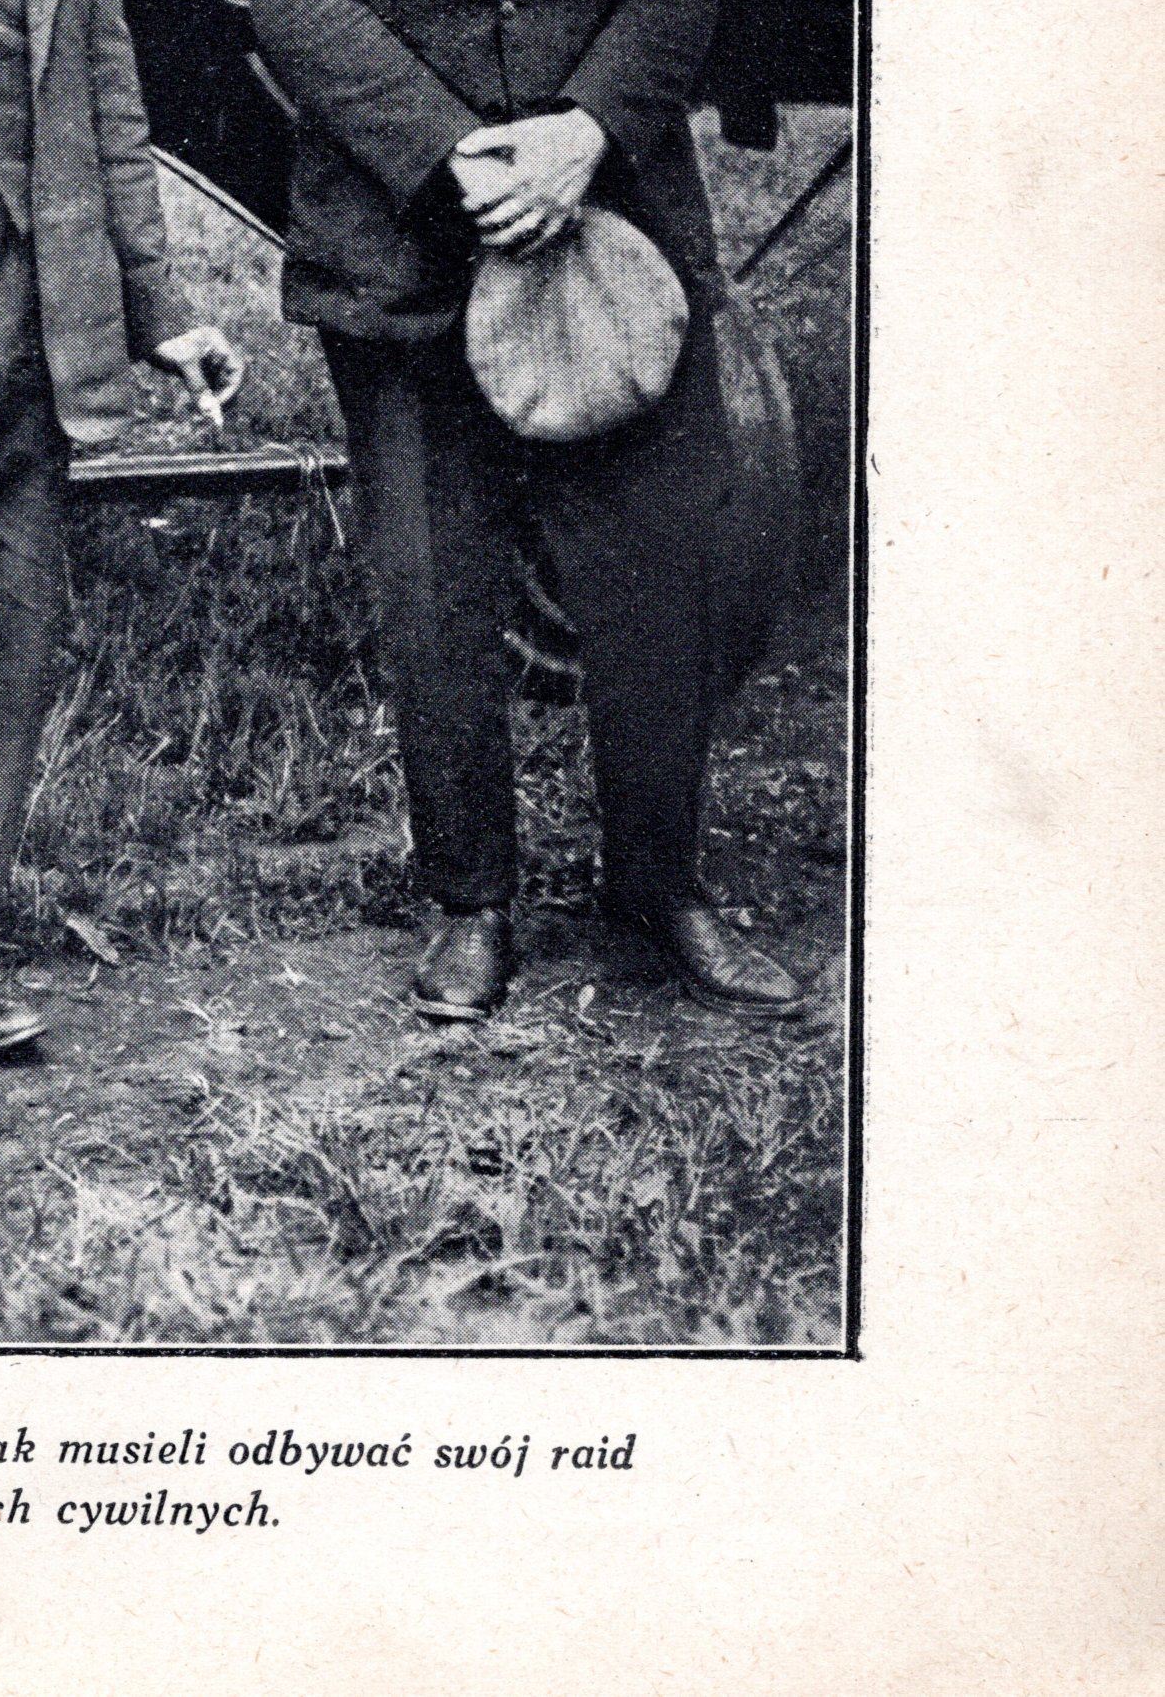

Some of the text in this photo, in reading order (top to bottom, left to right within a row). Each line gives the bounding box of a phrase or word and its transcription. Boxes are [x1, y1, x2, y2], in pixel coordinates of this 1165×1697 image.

[58, 1428, 207, 1466] musieli
[228, 1429, 412, 1476] odbywać
[433, 1434, 531, 1478] swój
[551, 1433, 637, 1471] raid
[57, 1488, 280, 1535] cywilnych.
